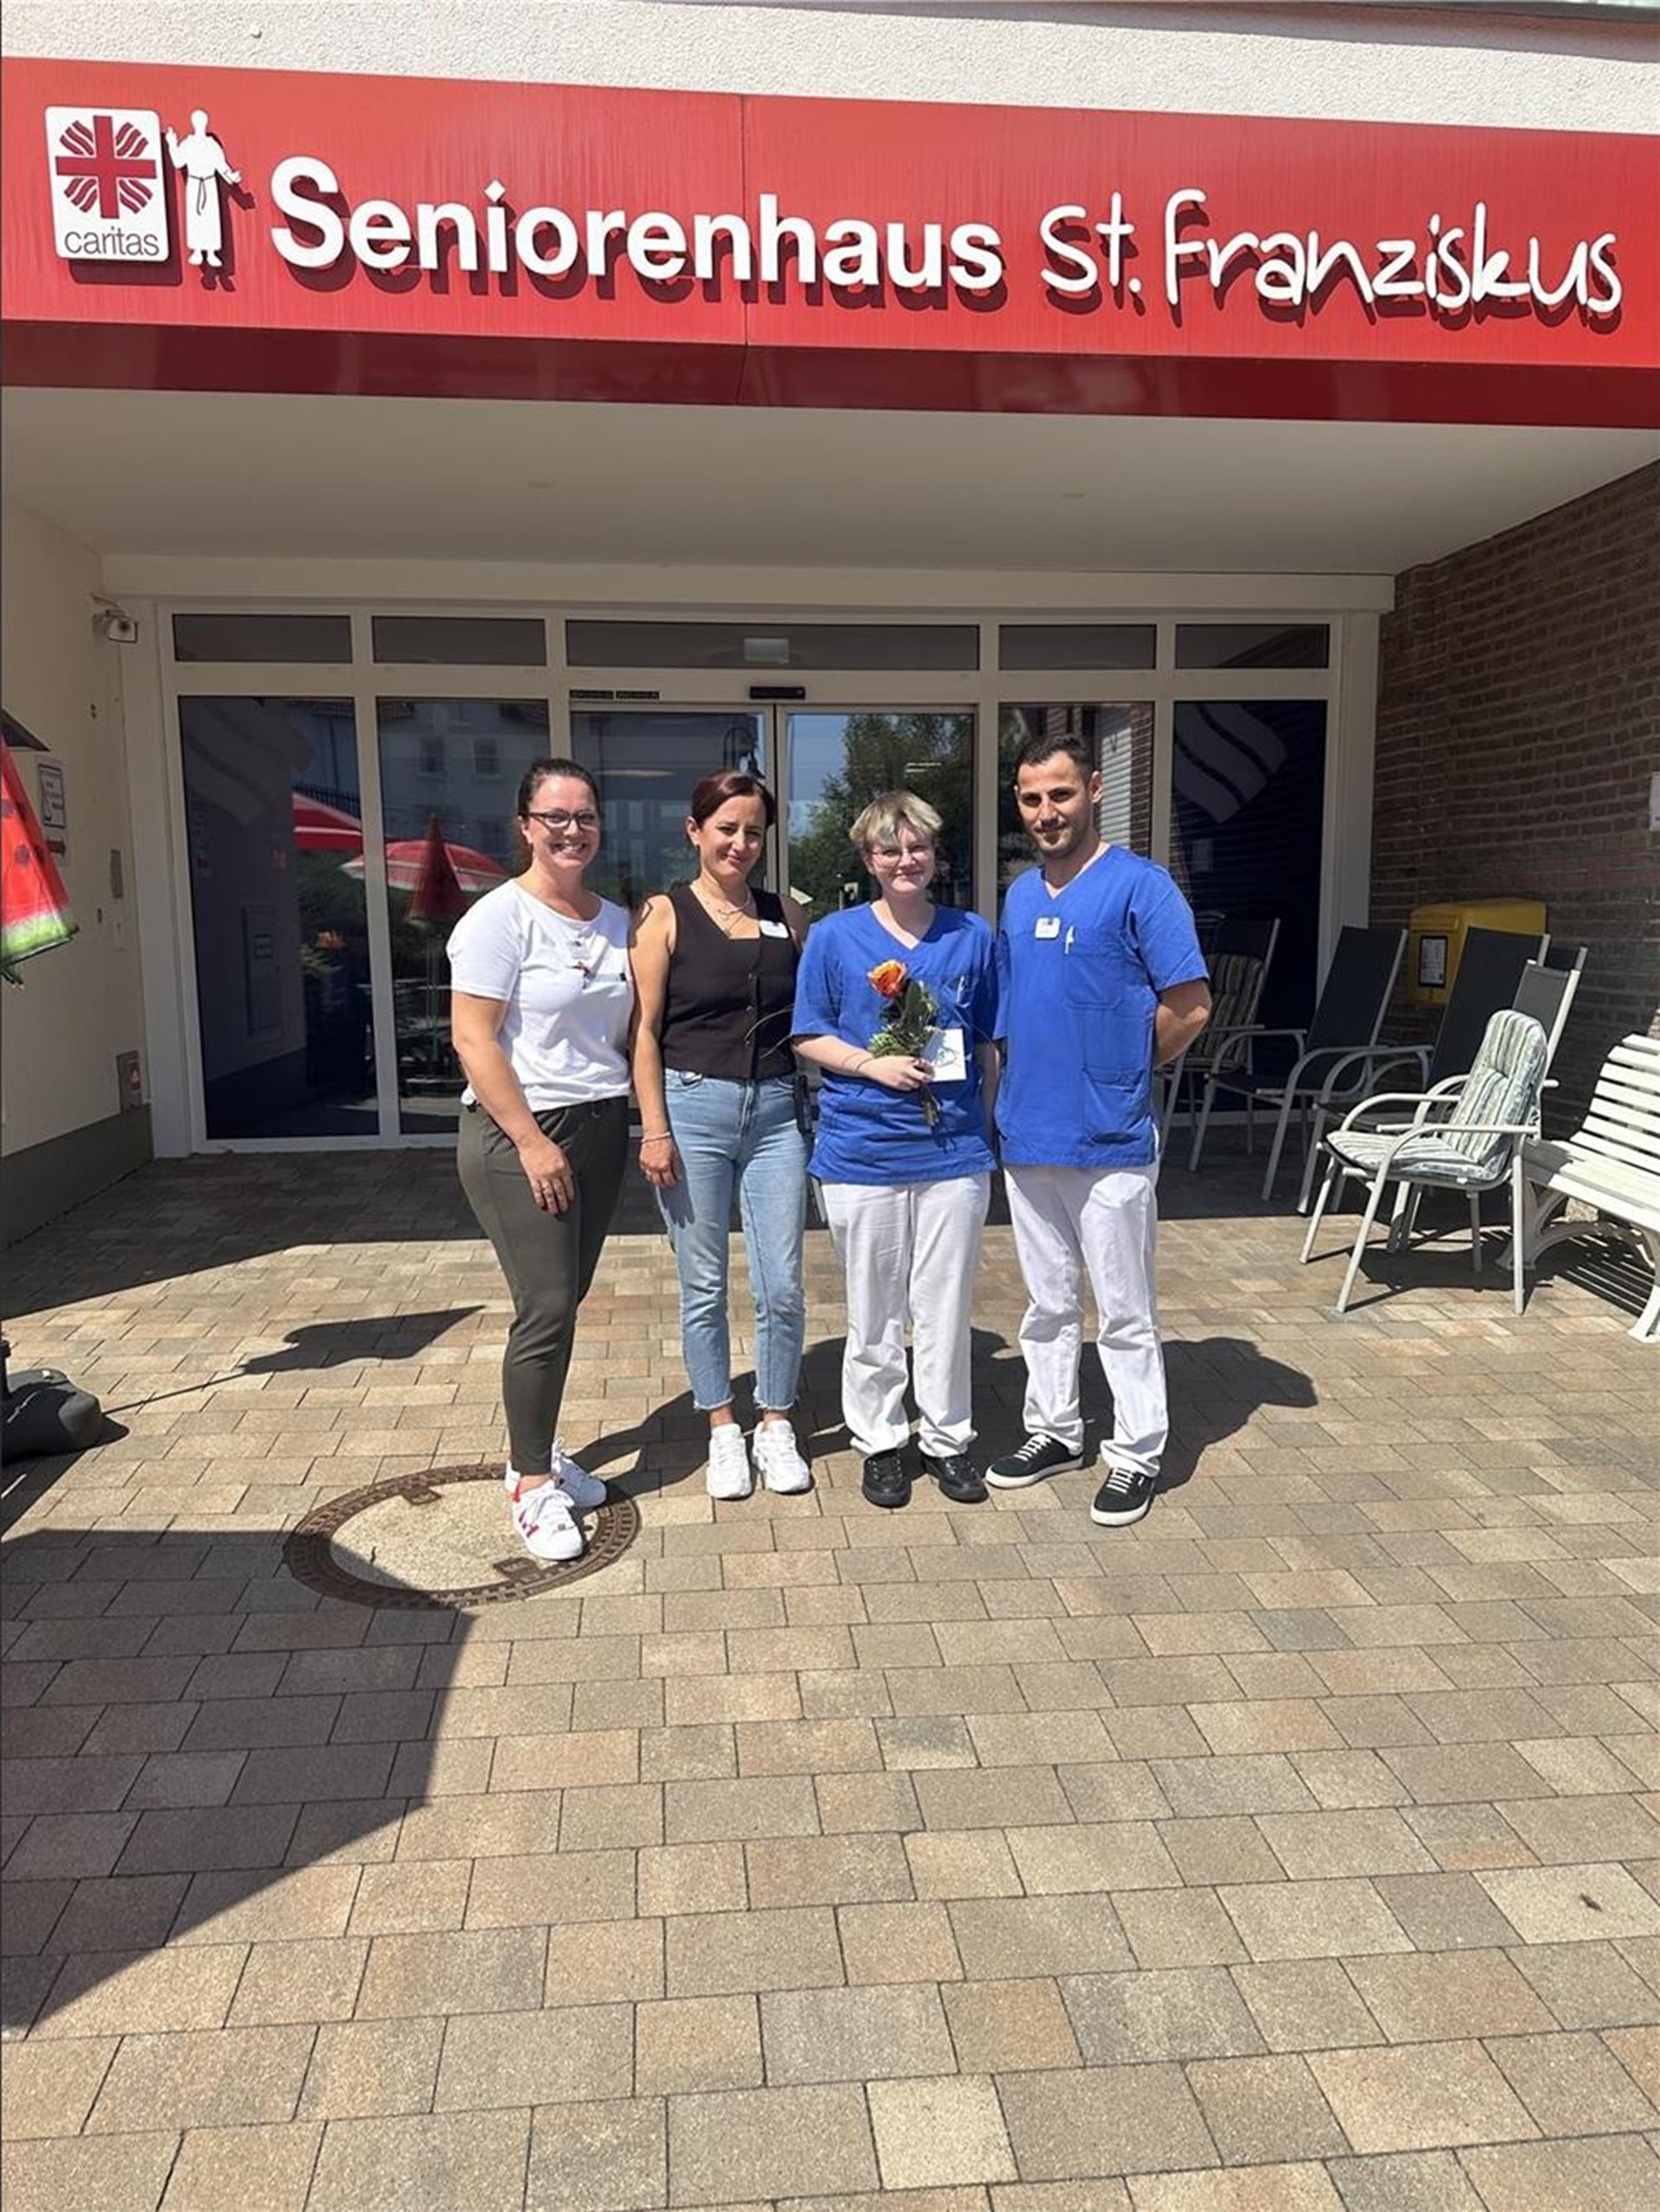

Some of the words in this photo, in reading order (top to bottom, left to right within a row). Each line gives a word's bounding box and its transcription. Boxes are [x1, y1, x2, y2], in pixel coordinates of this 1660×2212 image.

[64, 226, 159, 256] caritas
[271, 156, 1002, 292] Seniorenhaus
[1039, 191, 1142, 293] St.
[1164, 188, 1623, 312] Franziskus
